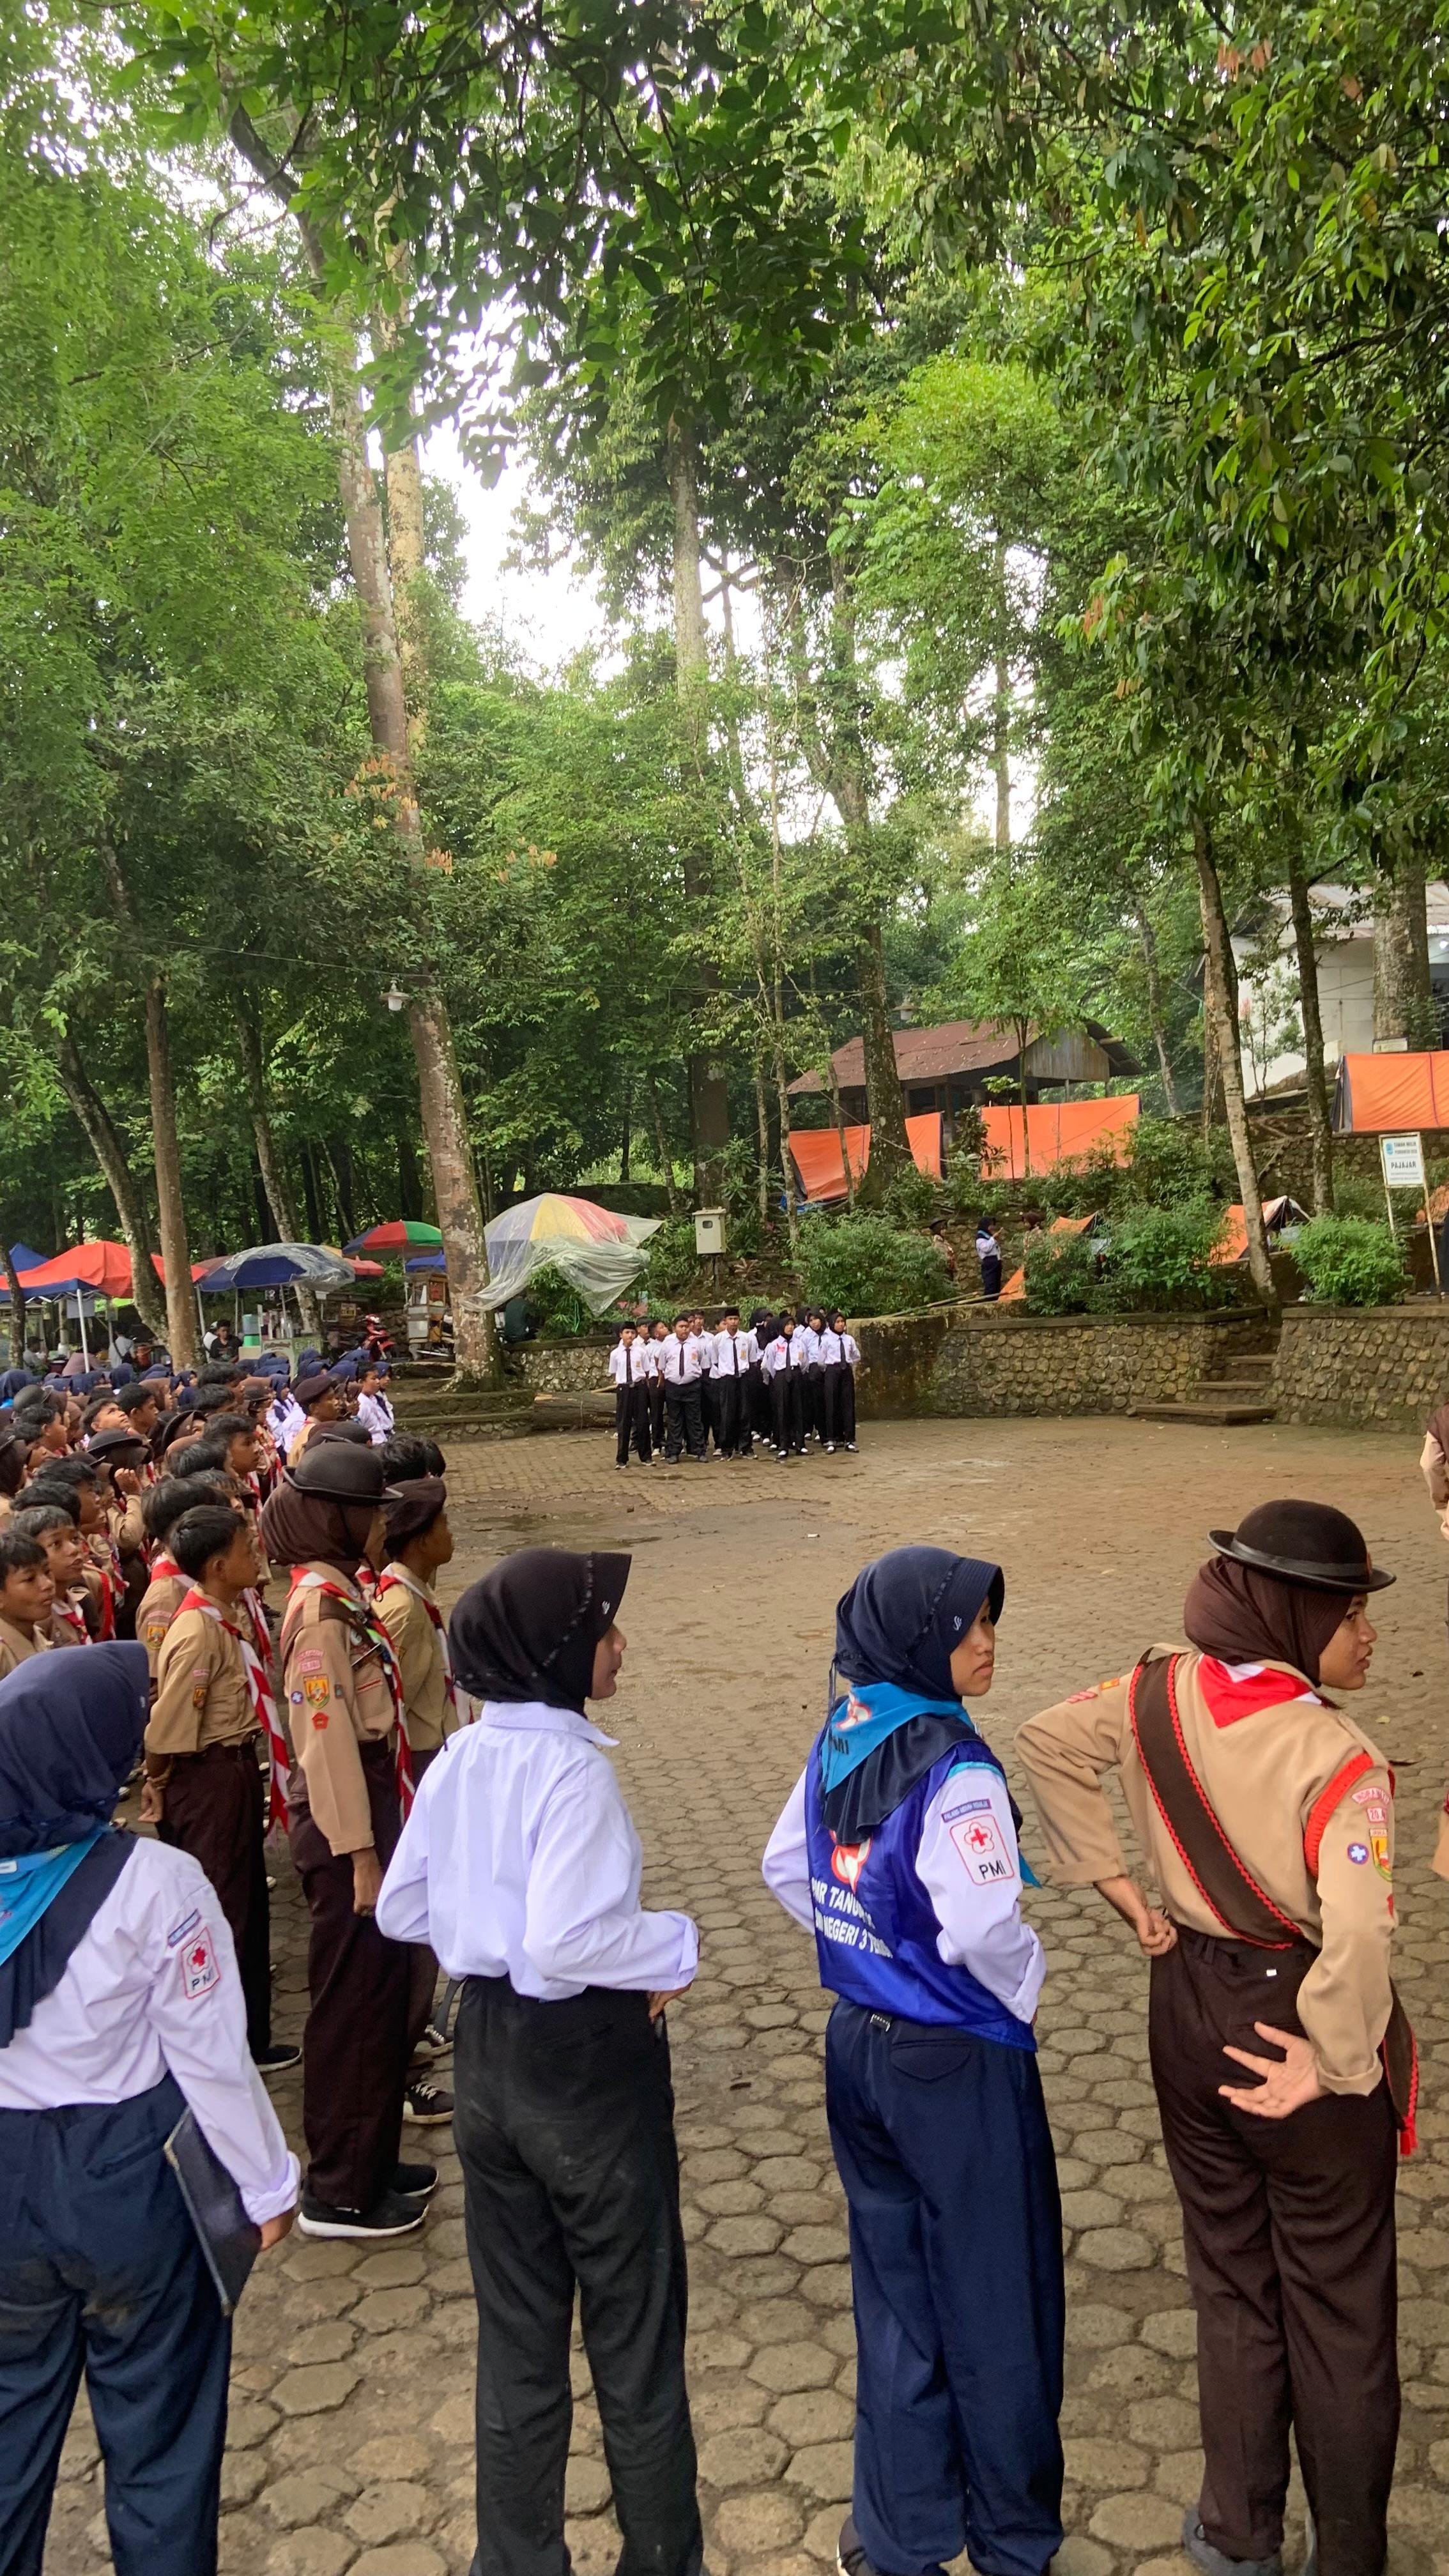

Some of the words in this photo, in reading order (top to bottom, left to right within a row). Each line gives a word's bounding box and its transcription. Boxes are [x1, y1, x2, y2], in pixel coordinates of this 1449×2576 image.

[979, 1860, 1006, 1880] PMI
[823, 1915, 860, 1947] NEGERI
[859, 1928, 868, 1951] 3
